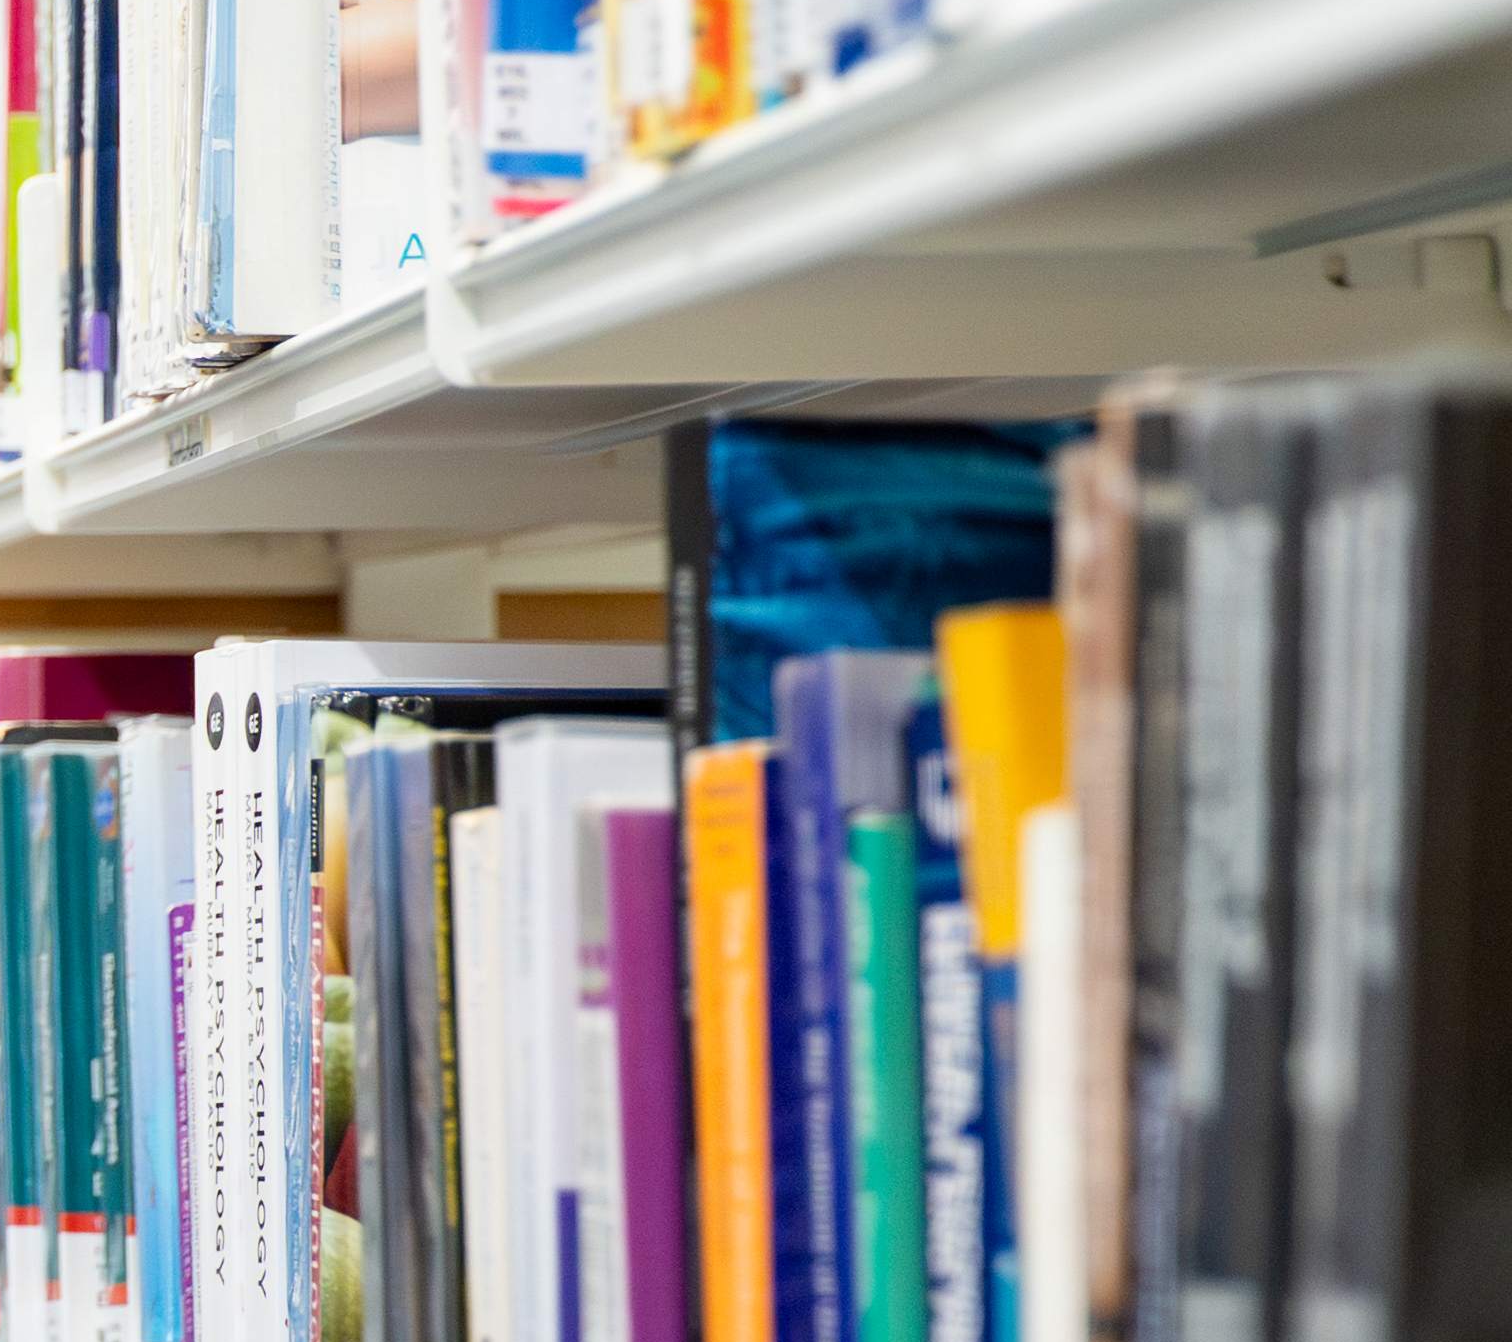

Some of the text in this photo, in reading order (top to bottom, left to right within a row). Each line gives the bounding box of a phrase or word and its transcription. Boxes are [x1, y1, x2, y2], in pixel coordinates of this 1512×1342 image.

[397, 232, 427, 270] A
[210, 711, 223, 733] 6E
[248, 712, 260, 734] 6E
[206, 901, 214, 1009] MURRAY
[246, 906, 255, 1015] MURRAY
[312, 903, 324, 1064] HEALTH
[215, 788, 226, 1286] HEALTH PSYCHOLOGY
[253, 791, 267, 1300] HEALTH PSYCHOLOGY
[207, 1053, 215, 1170] ESTACIO
[248, 1060, 256, 1180] ESTACIO
